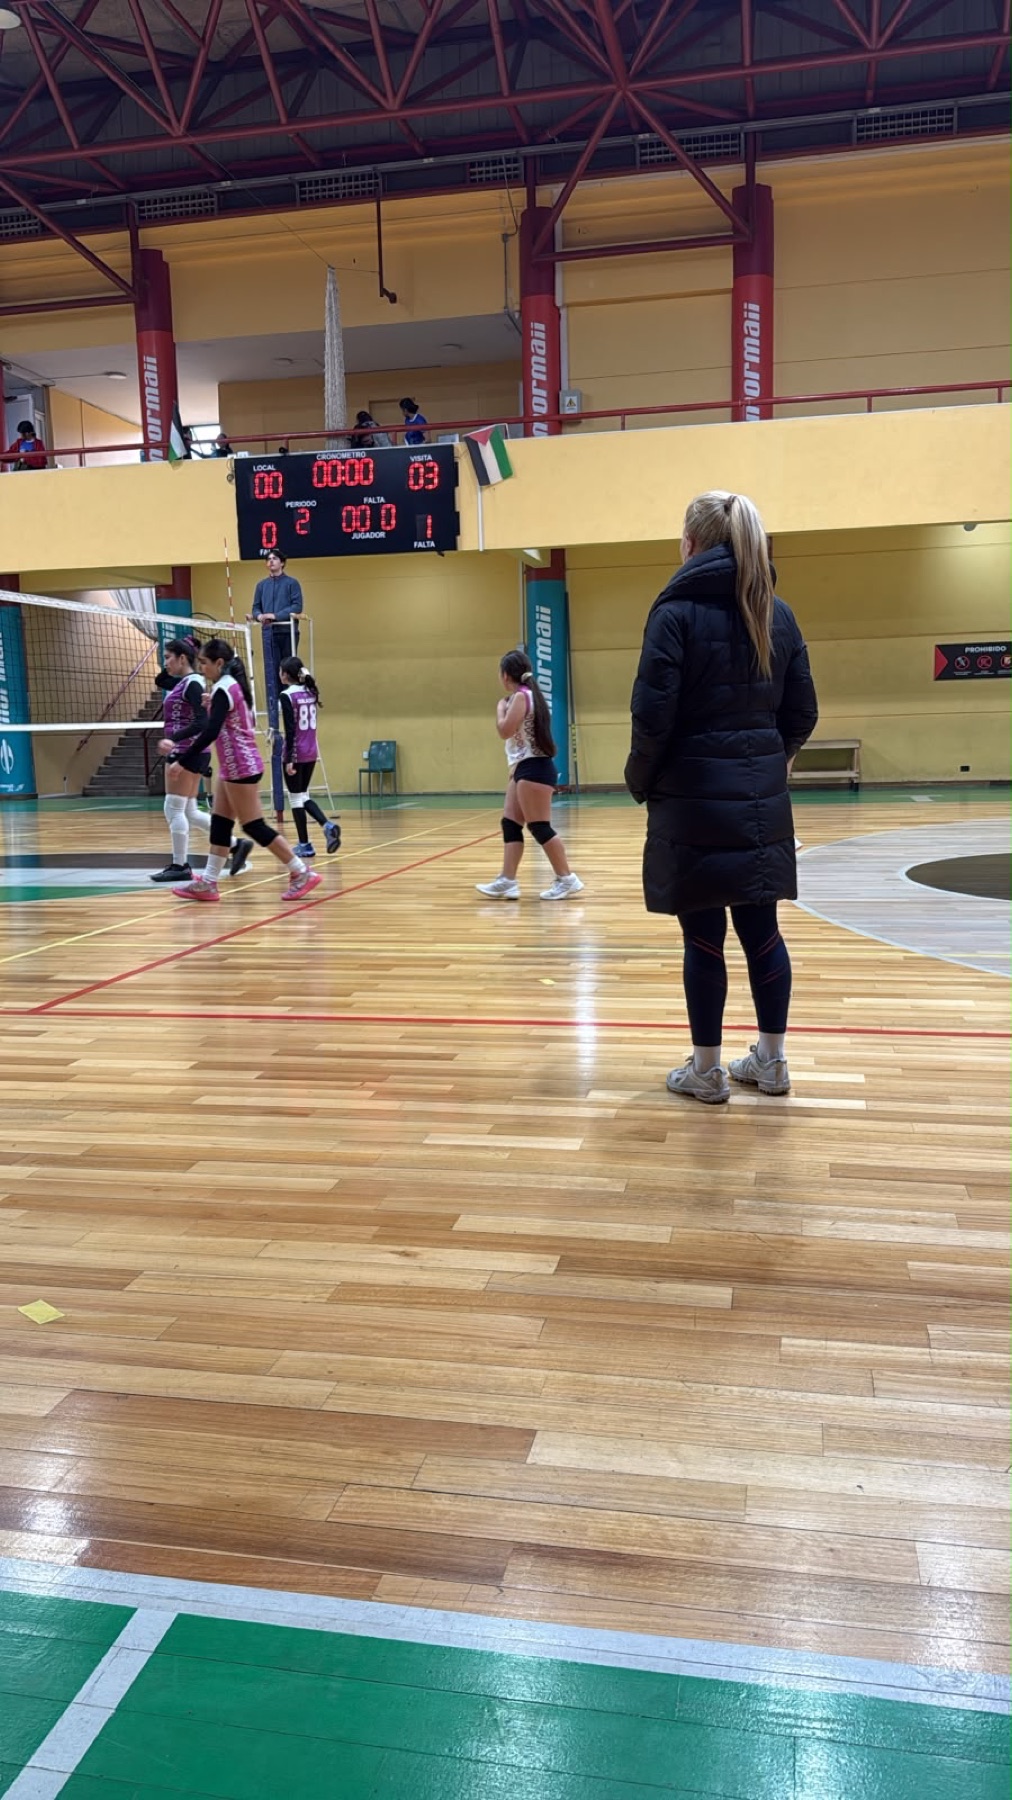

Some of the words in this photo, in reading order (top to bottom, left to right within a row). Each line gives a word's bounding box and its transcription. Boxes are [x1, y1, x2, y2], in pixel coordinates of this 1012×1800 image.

[316, 451, 366, 460] CRONOMETRO
[410, 454, 433, 462] VISITA
[254, 471, 283, 499] 00
[312, 458, 374, 488] 00:00
[408, 461, 439, 491] 03
[285, 500, 317, 508] PERIODO
[363, 496, 386, 504] FALTA
[295, 508, 310, 535] 2
[342, 505, 371, 533] 00
[381, 503, 397, 531] 0
[426, 514, 433, 539] 1
[261, 521, 277, 549] 0
[351, 531, 386, 540] JUGADOR
[413, 541, 436, 549] FALTA
[964, 645, 1007, 654] PROHIBIDO
[299, 704, 317, 730] 88
